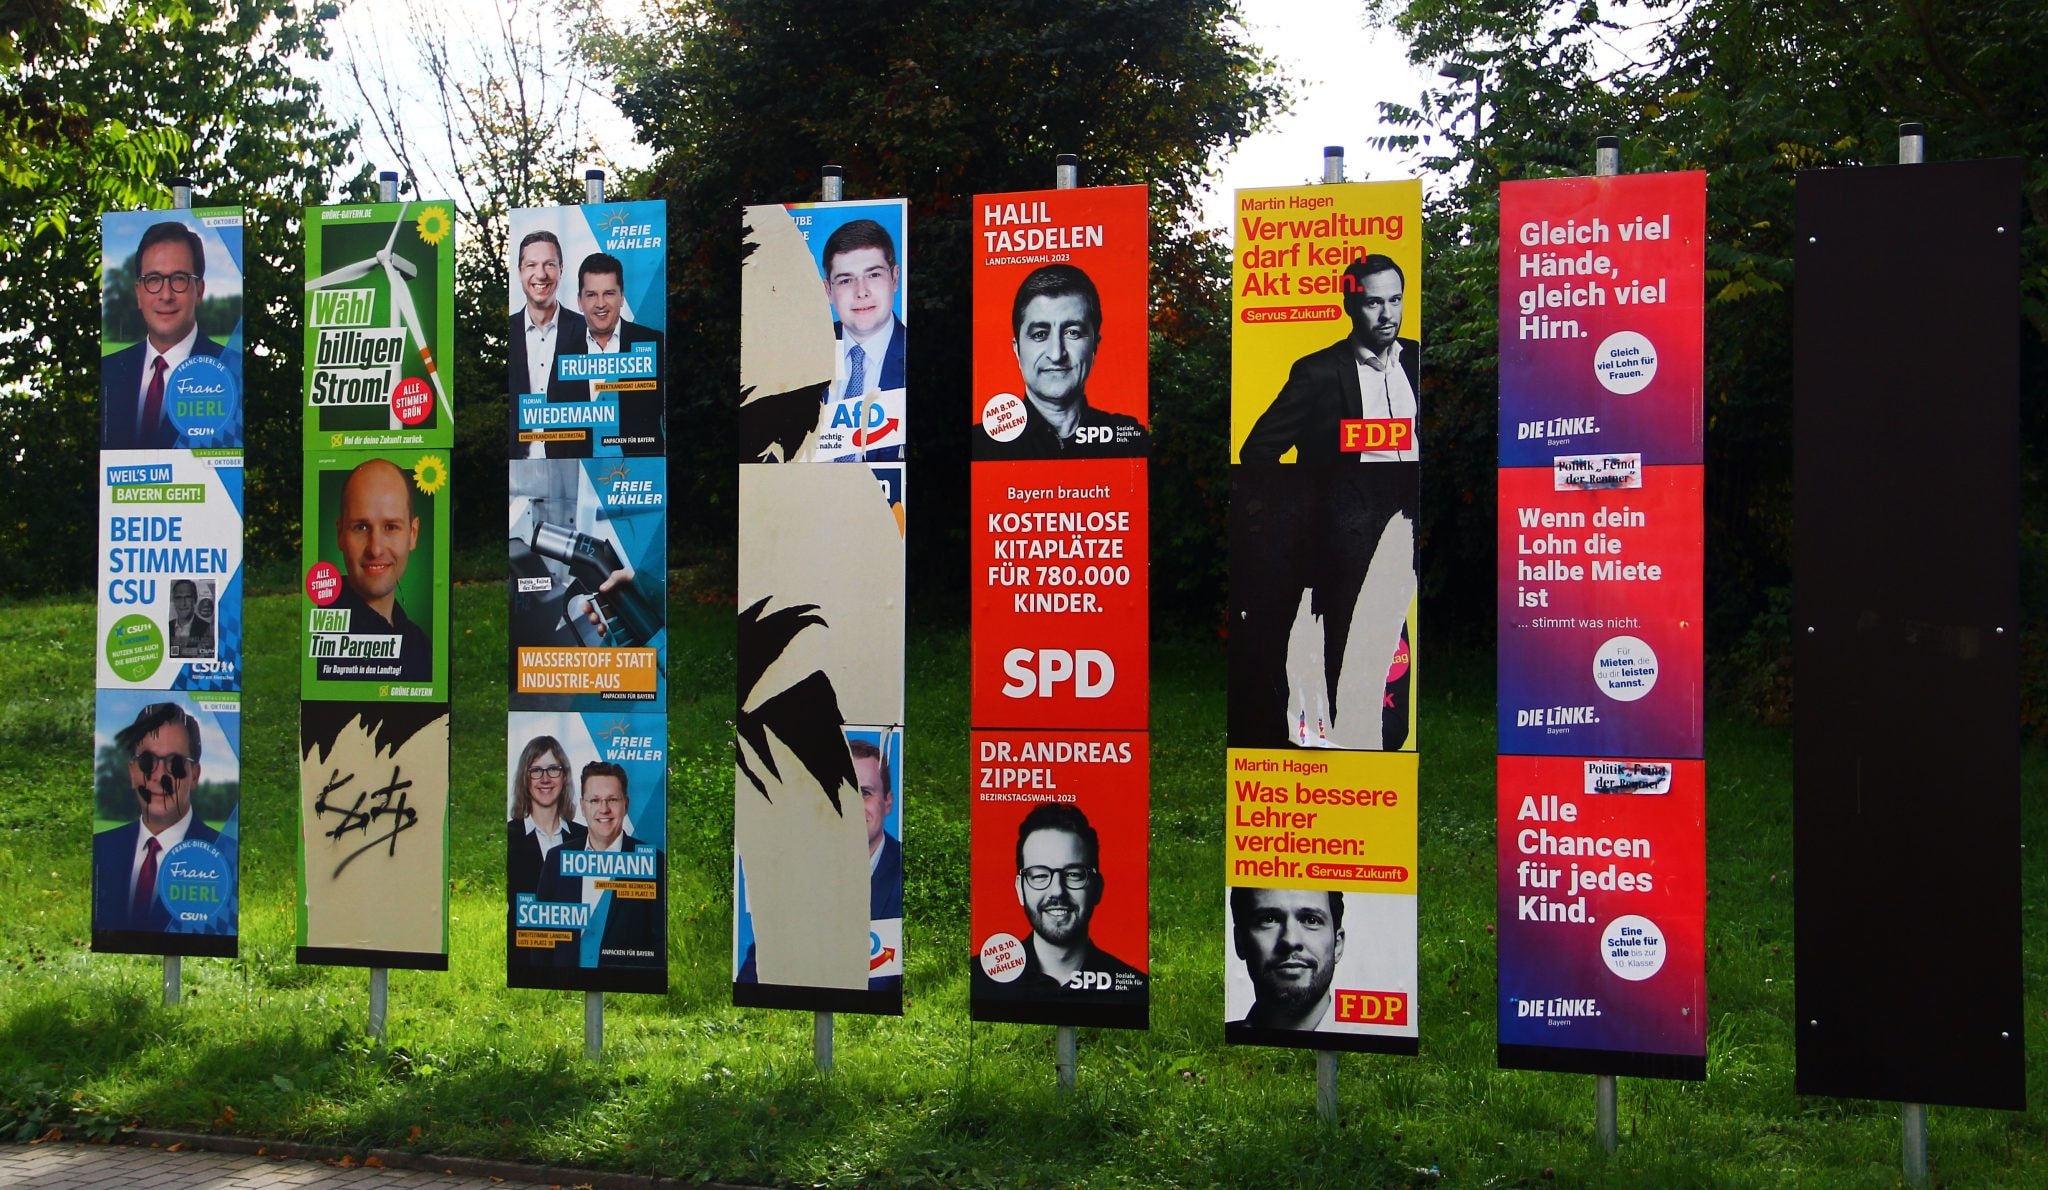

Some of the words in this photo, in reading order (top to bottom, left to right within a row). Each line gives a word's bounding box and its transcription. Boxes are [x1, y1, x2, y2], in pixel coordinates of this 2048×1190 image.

[1242, 198, 1285, 210] Martin
[1290, 195, 1334, 211] Hagen
[984, 201, 1052, 226] HALIL
[611, 224, 652, 237] FREIE
[1242, 212, 1404, 242] Verwaltung
[1520, 218, 1610, 246] Gleich
[1618, 214, 1670, 242] viel
[606, 235, 662, 250] WÄHLER
[984, 225, 1103, 252] TASDELEN
[985, 255, 1050, 266] LANDTAGSWAHL
[1051, 254, 1070, 263] 2023
[1242, 242, 1300, 269] darf
[1308, 240, 1366, 266] kein
[1520, 250, 1618, 280] Hände,
[1241, 272, 1290, 297] Akt
[1298, 271, 1365, 296] sein.
[1519, 280, 1605, 314] gleich
[1614, 278, 1666, 304] viel
[315, 290, 372, 326] Wähl
[1246, 309, 1288, 321] Servus
[1290, 308, 1336, 320] Zukunft
[1519, 315, 1588, 340] Hirn.
[317, 331, 402, 370] billigen
[1610, 346, 1640, 358] Gleich
[562, 354, 653, 376] FRÜHBEISSER
[1597, 360, 1614, 370] viel
[1616, 358, 1639, 370] Lohn
[1640, 356, 1654, 366] für
[1609, 370, 1644, 380] Frauen.
[177, 378, 225, 394] Franc
[312, 369, 392, 404] Strom!
[403, 382, 420, 395] ALLE
[176, 400, 226, 417] DIERL
[396, 394, 428, 409] STIMMEN
[986, 407, 1000, 418] AM
[1000, 400, 1018, 412] 8.10.
[402, 406, 422, 418] GRÜN
[523, 406, 615, 425] WIEDEMANN
[830, 400, 884, 428] AfD
[996, 411, 1012, 424] SPD
[990, 416, 1026, 437] WÄHLEN!
[1075, 426, 1114, 444] SPD
[1344, 422, 1408, 448] FDP
[1518, 422, 1544, 440] DIE
[1548, 438, 1570, 447] Bayern
[1559, 460, 1594, 472] Politik
[110, 469, 146, 483] WEIL’S
[150, 468, 170, 481] UM
[1566, 474, 1585, 484] der
[116, 488, 162, 501] BAYERN
[166, 488, 200, 500] GEHT!
[612, 480, 652, 492] FREIE
[1007, 487, 1054, 504] Bayern
[1058, 485, 1110, 499] braucht
[607, 492, 662, 505] WÄHLER
[988, 511, 1130, 534] KOSTENLOSE
[1518, 508, 1586, 528] Wenn
[1592, 506, 1646, 528] dein
[110, 516, 182, 542] BEIDE
[994, 534, 1124, 560] KITAPLÄTZE
[1518, 534, 1578, 555] Lohn
[1584, 534, 1622, 555] die
[109, 548, 227, 574] STIMMEN
[316, 568, 330, 579] ALLE
[988, 562, 1030, 586] FÜR
[1036, 565, 1130, 586] 780.000
[1518, 560, 1584, 581] halbe
[1591, 560, 1662, 581] Miete
[108, 579, 156, 605] CSU
[312, 578, 336, 590] STIMMEN
[318, 588, 333, 600] GRÜN
[1014, 592, 1104, 614] KINDER.
[1518, 587, 1548, 608] ist
[313, 610, 348, 631] Wähl
[1532, 616, 1576, 629] stimmt
[1579, 619, 1604, 629] was
[1608, 616, 1642, 629] nicht.
[312, 635, 336, 656] Tim
[339, 635, 396, 659] Pargent
[1617, 648, 1630, 656] Für
[522, 652, 612, 668] WASSERSTOFF
[616, 652, 654, 668] STATT
[1600, 658, 1636, 668] Mieten,
[1638, 656, 1650, 665] die
[366, 665, 376, 674] den
[377, 665, 402, 676] Landtag!
[1002, 648, 1115, 698] SPD
[1621, 668, 1655, 677] leisten
[522, 672, 620, 689] INDUSTRIE-AUS
[1608, 678, 1644, 688] kannst.
[1517, 709, 1544, 728] DIE
[1547, 727, 1570, 736] Bayern
[612, 736, 652, 748] FREIE
[606, 748, 662, 762] WÄHLER
[1234, 758, 1279, 772] Martin
[1283, 760, 1328, 776] Hagen
[1588, 763, 1624, 774] Politik
[980, 768, 1056, 790] ZIPPEL
[1596, 776, 1615, 788] der
[980, 793, 1056, 802] BEZIRKSTAGSWAHL
[1057, 794, 1077, 803] 2023
[1235, 780, 1288, 804] Was
[1296, 782, 1398, 807] bessere
[1235, 805, 1317, 829] Lehrer
[1517, 795, 1578, 822] Alle
[1234, 832, 1365, 856] verdienen:
[1518, 828, 1650, 859] Chancen
[170, 861, 220, 878] Franc
[562, 853, 654, 876] HOFMANN
[1235, 856, 1302, 878] mehr.
[1311, 866, 1352, 878] Servus
[1356, 867, 1402, 880] Zukunft
[1517, 860, 1562, 890] für
[1568, 863, 1653, 896] jedes
[170, 885, 220, 903] DIERL
[519, 904, 588, 926] SCHERM
[1518, 895, 1596, 924] Kind.
[1621, 926, 1642, 936] Eine
[984, 946, 998, 958] AM
[998, 940, 1016, 951] 8.10.
[1608, 937, 1641, 947] Schule
[1643, 936, 1658, 946] für
[995, 952, 1011, 964] SPD
[1612, 948, 1630, 958] alle
[1630, 949, 1642, 957] bis
[988, 957, 1024, 976] WÄHLEN!
[1070, 970, 1112, 990] SPD
[1340, 994, 1402, 1021] FDP
[1518, 998, 1544, 1018] DIE
[1548, 1018, 1571, 1026] Bayern
